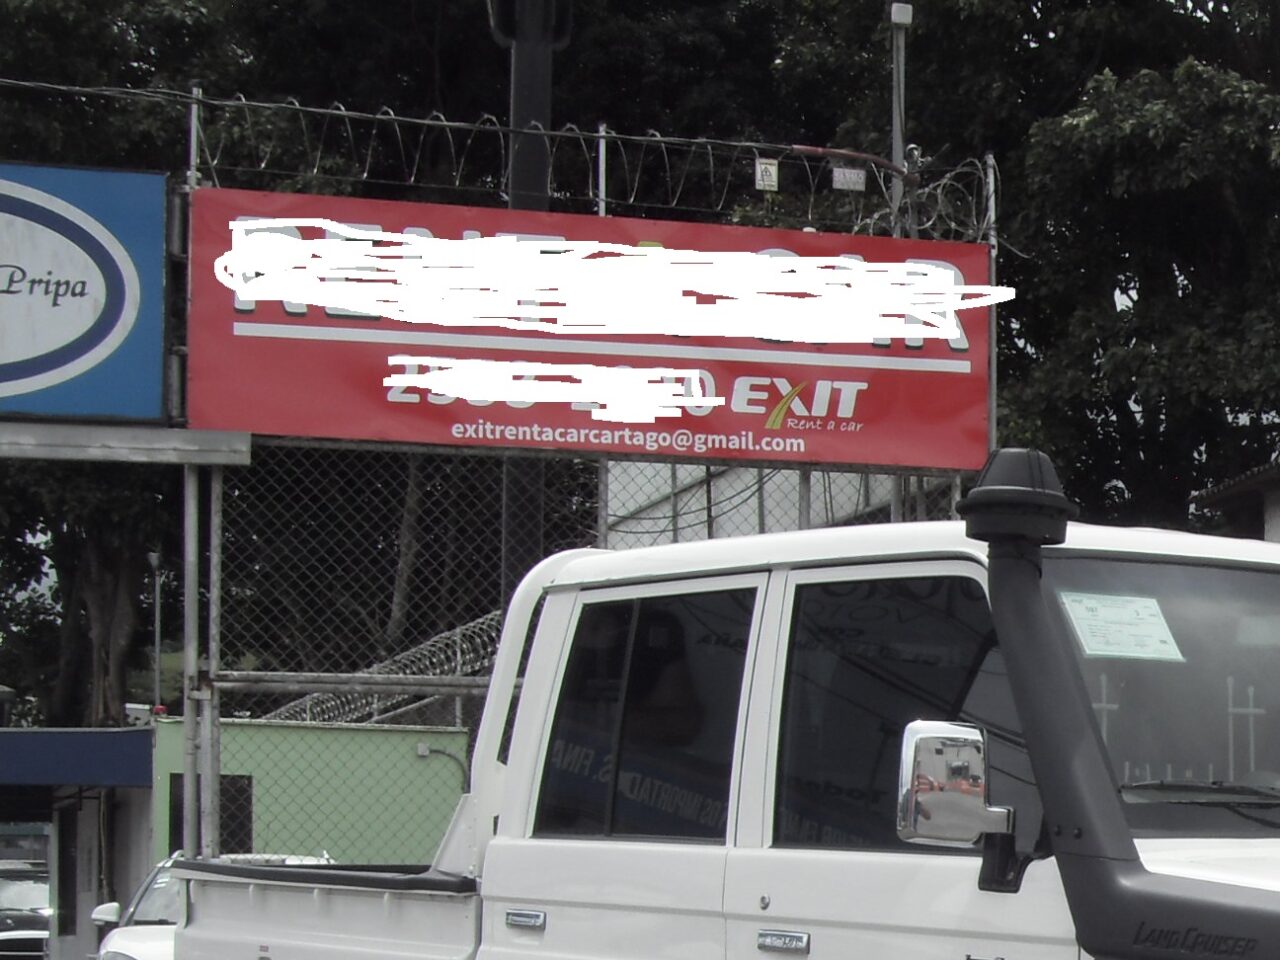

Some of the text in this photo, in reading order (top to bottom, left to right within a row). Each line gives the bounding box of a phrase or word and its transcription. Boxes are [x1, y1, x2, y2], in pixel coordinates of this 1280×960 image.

[0, 264, 89, 307] Pripa
[731, 375, 868, 427] EXIT
[451, 420, 806, 453] exitrentacarcartago@gmail.com
[786, 417, 865, 432] Rent a car
